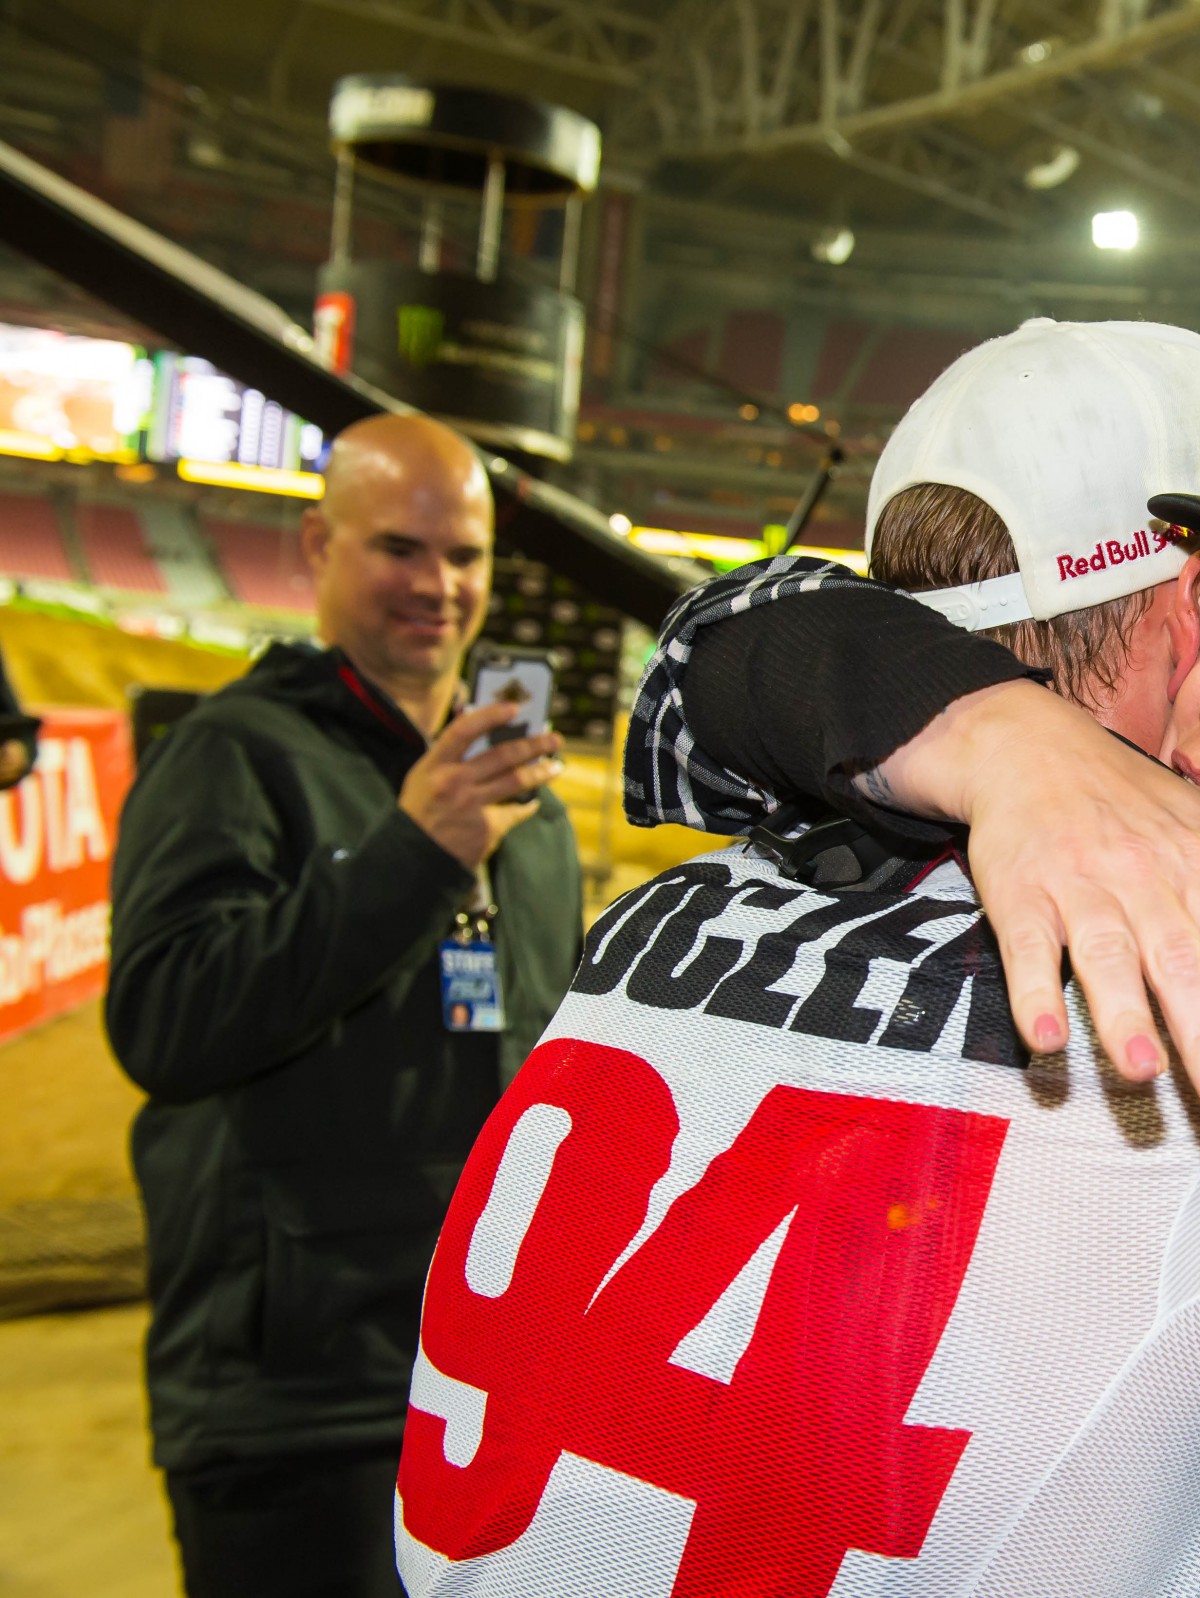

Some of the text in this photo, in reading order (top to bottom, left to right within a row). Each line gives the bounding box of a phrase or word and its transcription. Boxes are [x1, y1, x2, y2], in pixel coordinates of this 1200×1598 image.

[1056, 530, 1150, 581] Red Bull
[396, 1037, 1012, 1598] 94
